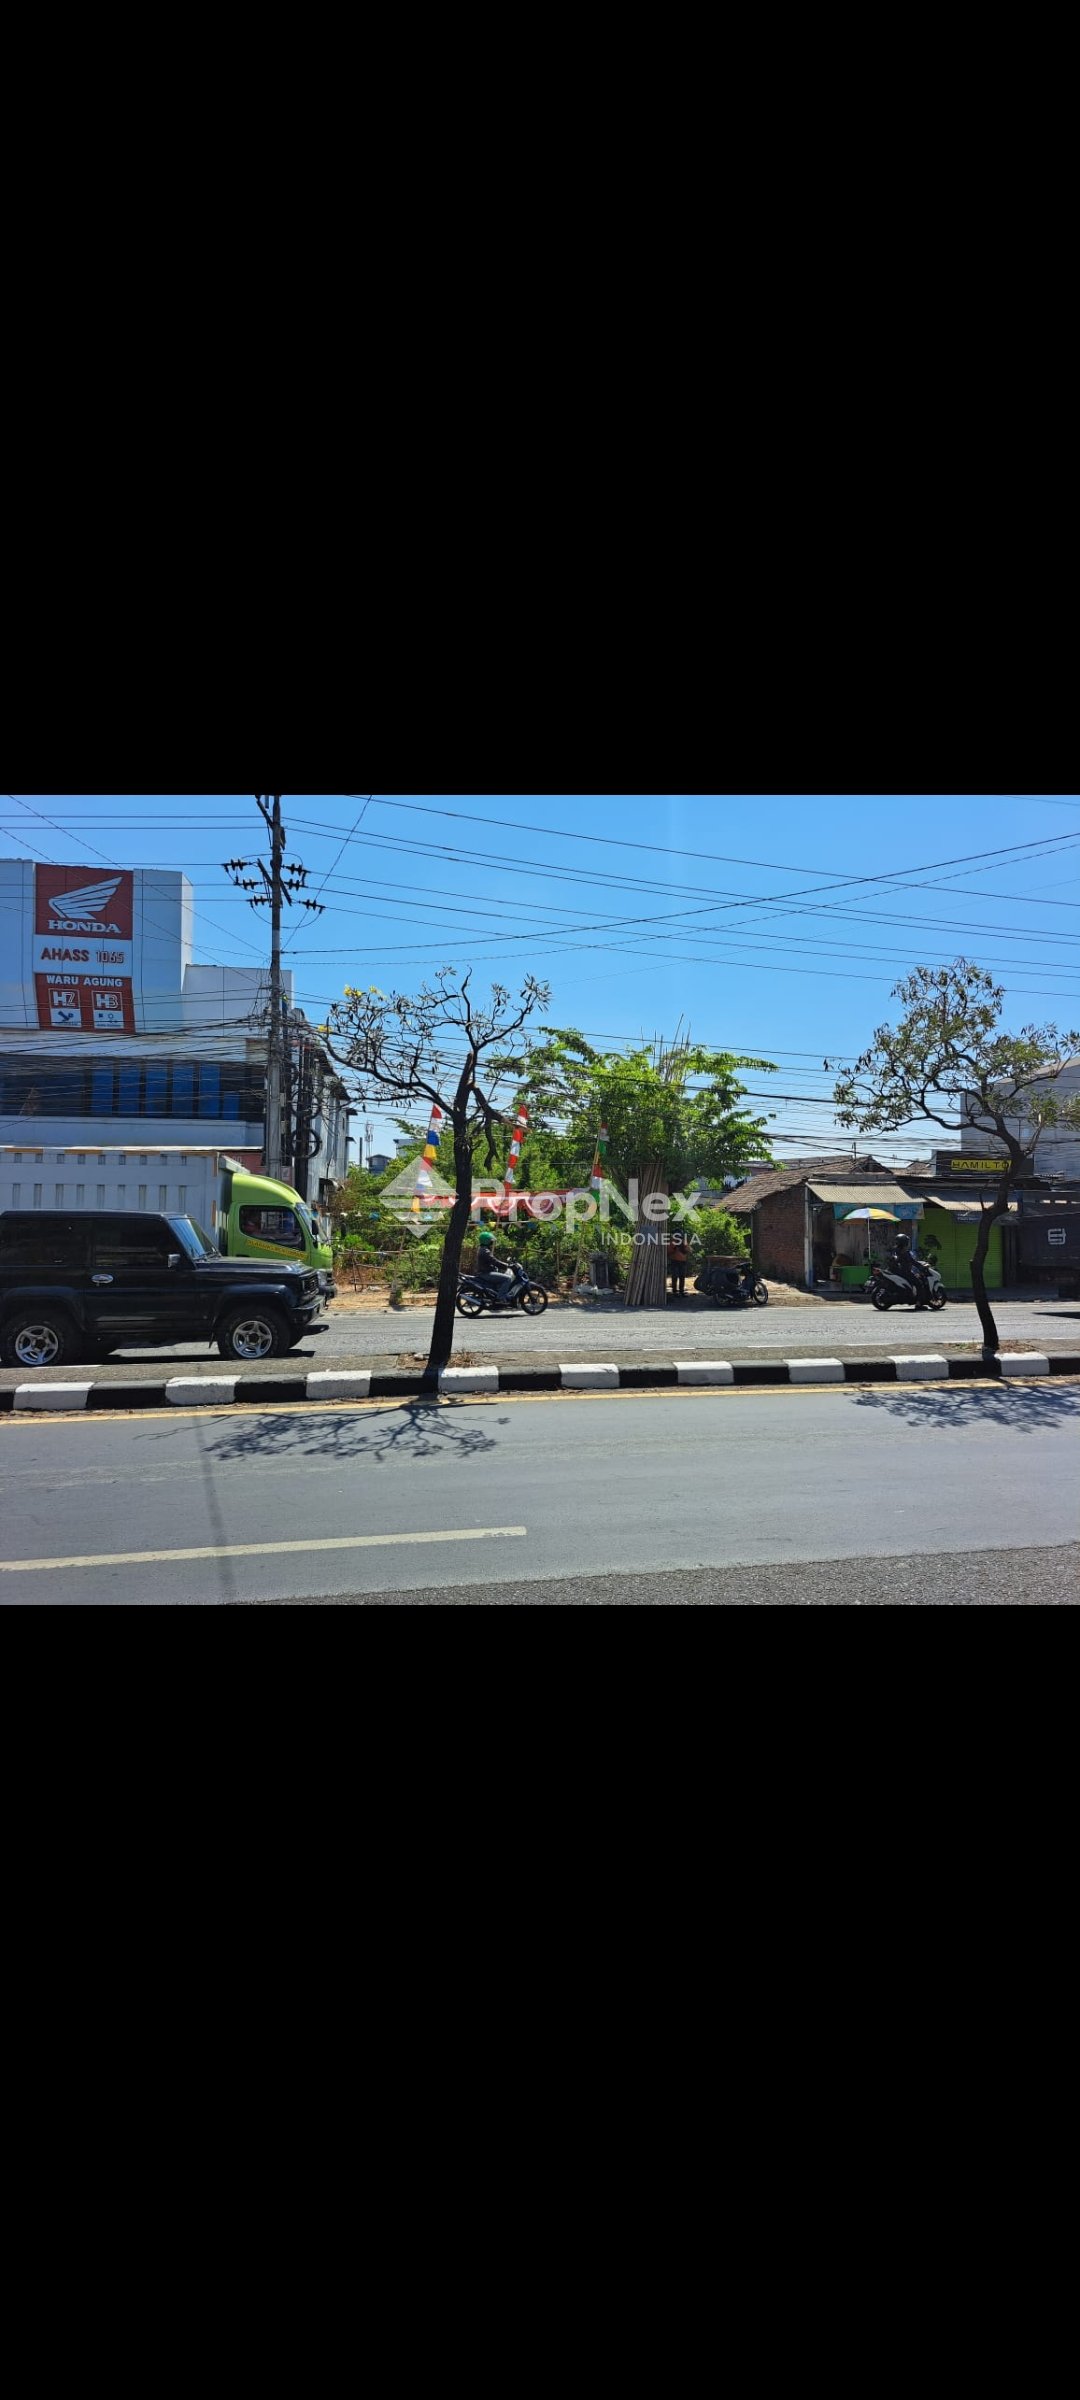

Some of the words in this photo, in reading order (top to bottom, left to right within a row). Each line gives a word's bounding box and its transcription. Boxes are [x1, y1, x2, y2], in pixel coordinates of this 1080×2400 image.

[48, 919, 121, 933] HONDA
[41, 947, 89, 962] AHASS
[96, 950, 124, 964] 1065
[46, 974, 79, 985] WARU
[83, 977, 123, 987] AGUNG
[953, 1161, 1010, 1169] HAMILTO
